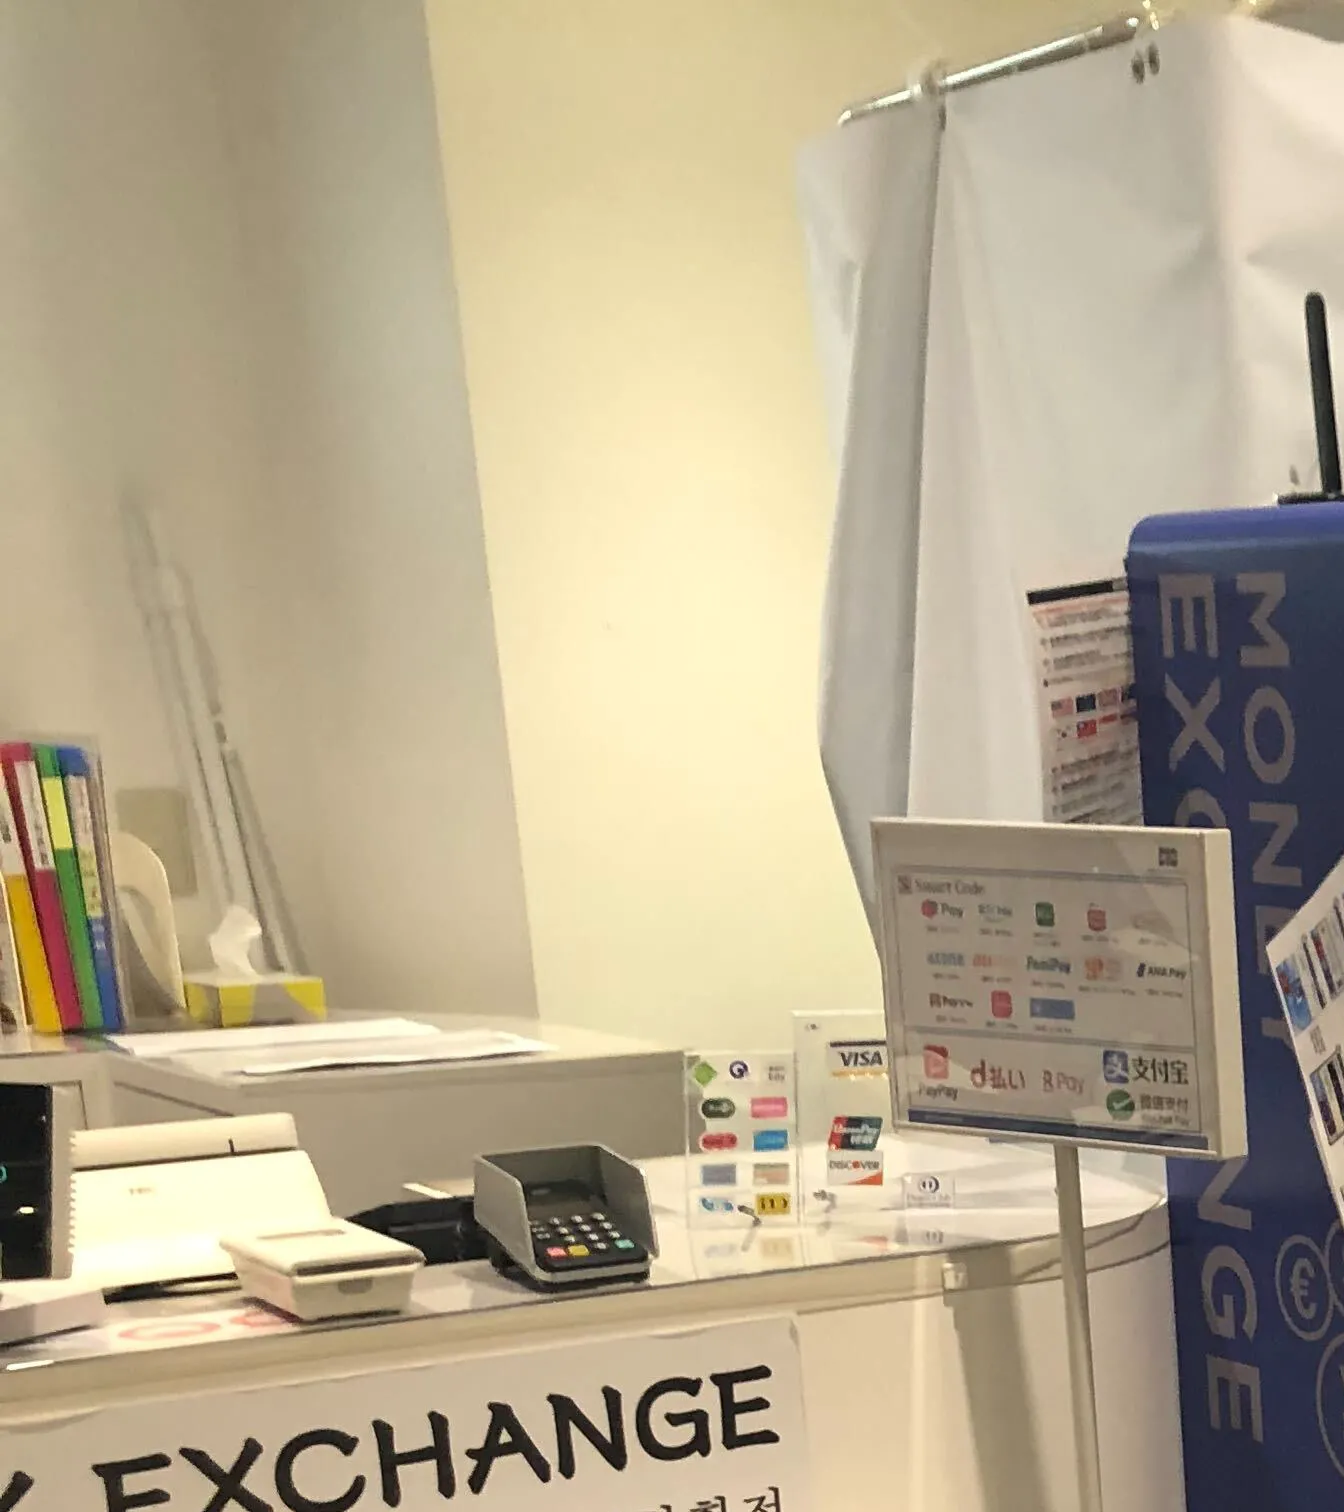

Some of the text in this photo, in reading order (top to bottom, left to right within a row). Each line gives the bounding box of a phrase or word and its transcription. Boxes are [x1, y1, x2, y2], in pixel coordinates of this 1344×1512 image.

[839, 1050, 884, 1067] VISA
[1131, 1056, 1189, 1085] 支付宝
[969, 1059, 1026, 1090] d払い
[1056, 1071, 1085, 1096] Pay
